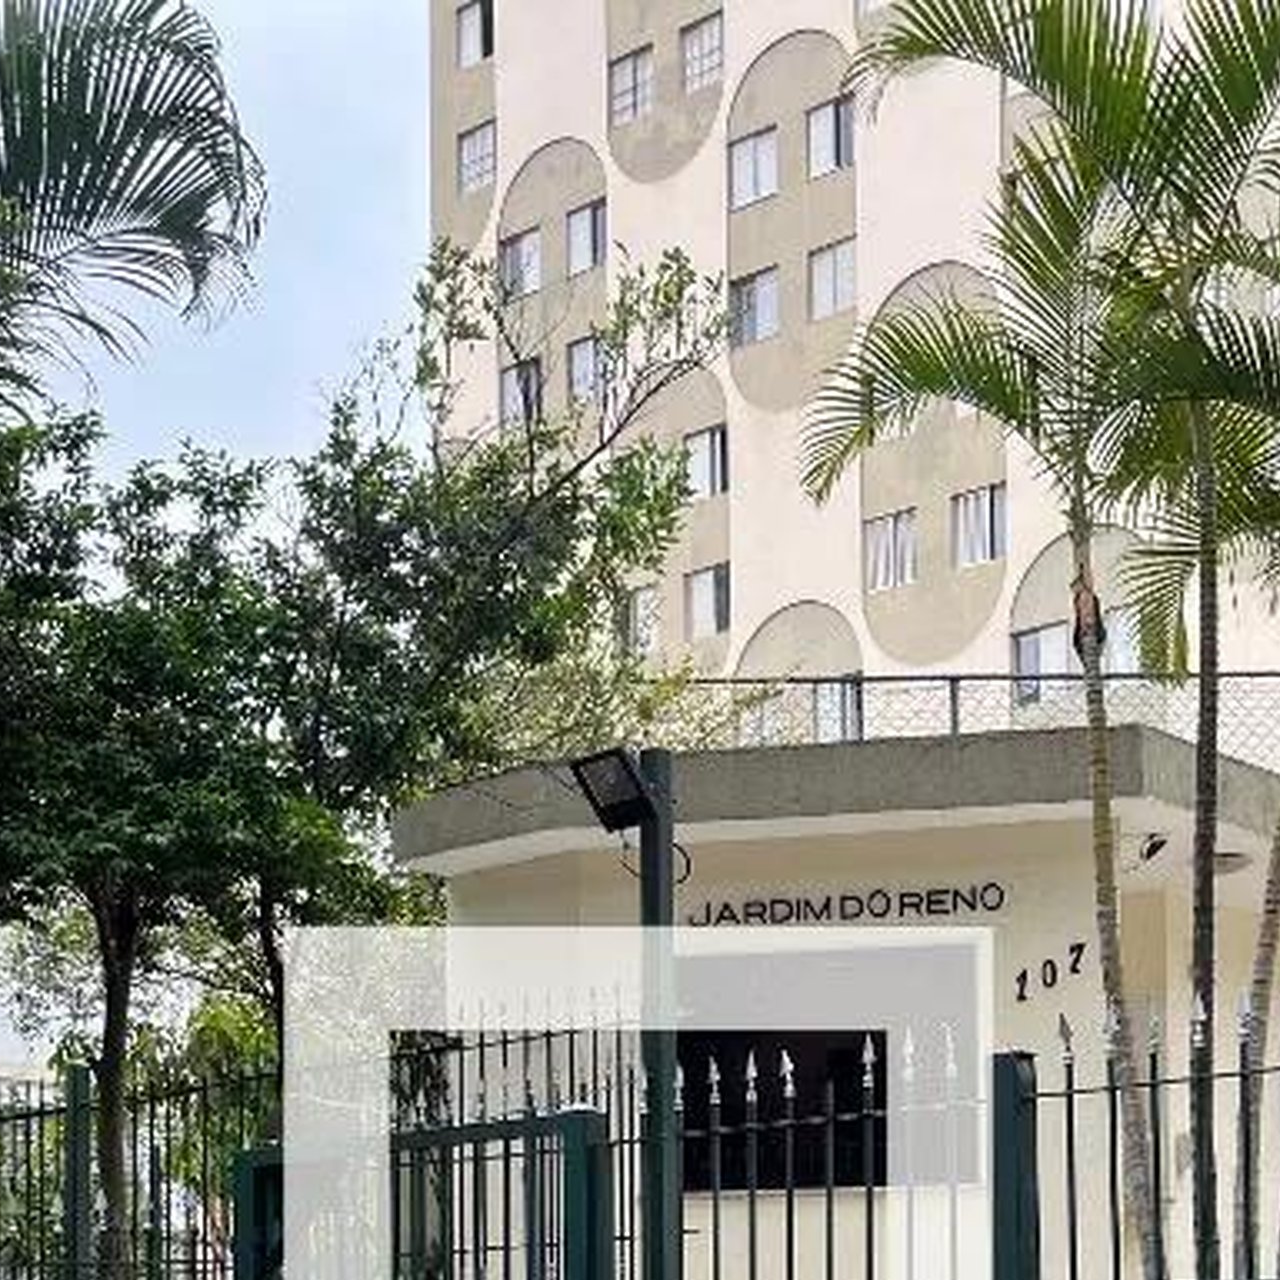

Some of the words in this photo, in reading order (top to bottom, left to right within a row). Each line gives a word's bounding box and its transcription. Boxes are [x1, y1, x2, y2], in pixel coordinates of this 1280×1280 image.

[688, 895, 832, 927] JARDIM
[839, 889, 891, 920] DO
[898, 882, 1005, 917] RENO
[1015, 942, 1087, 1002] 107
